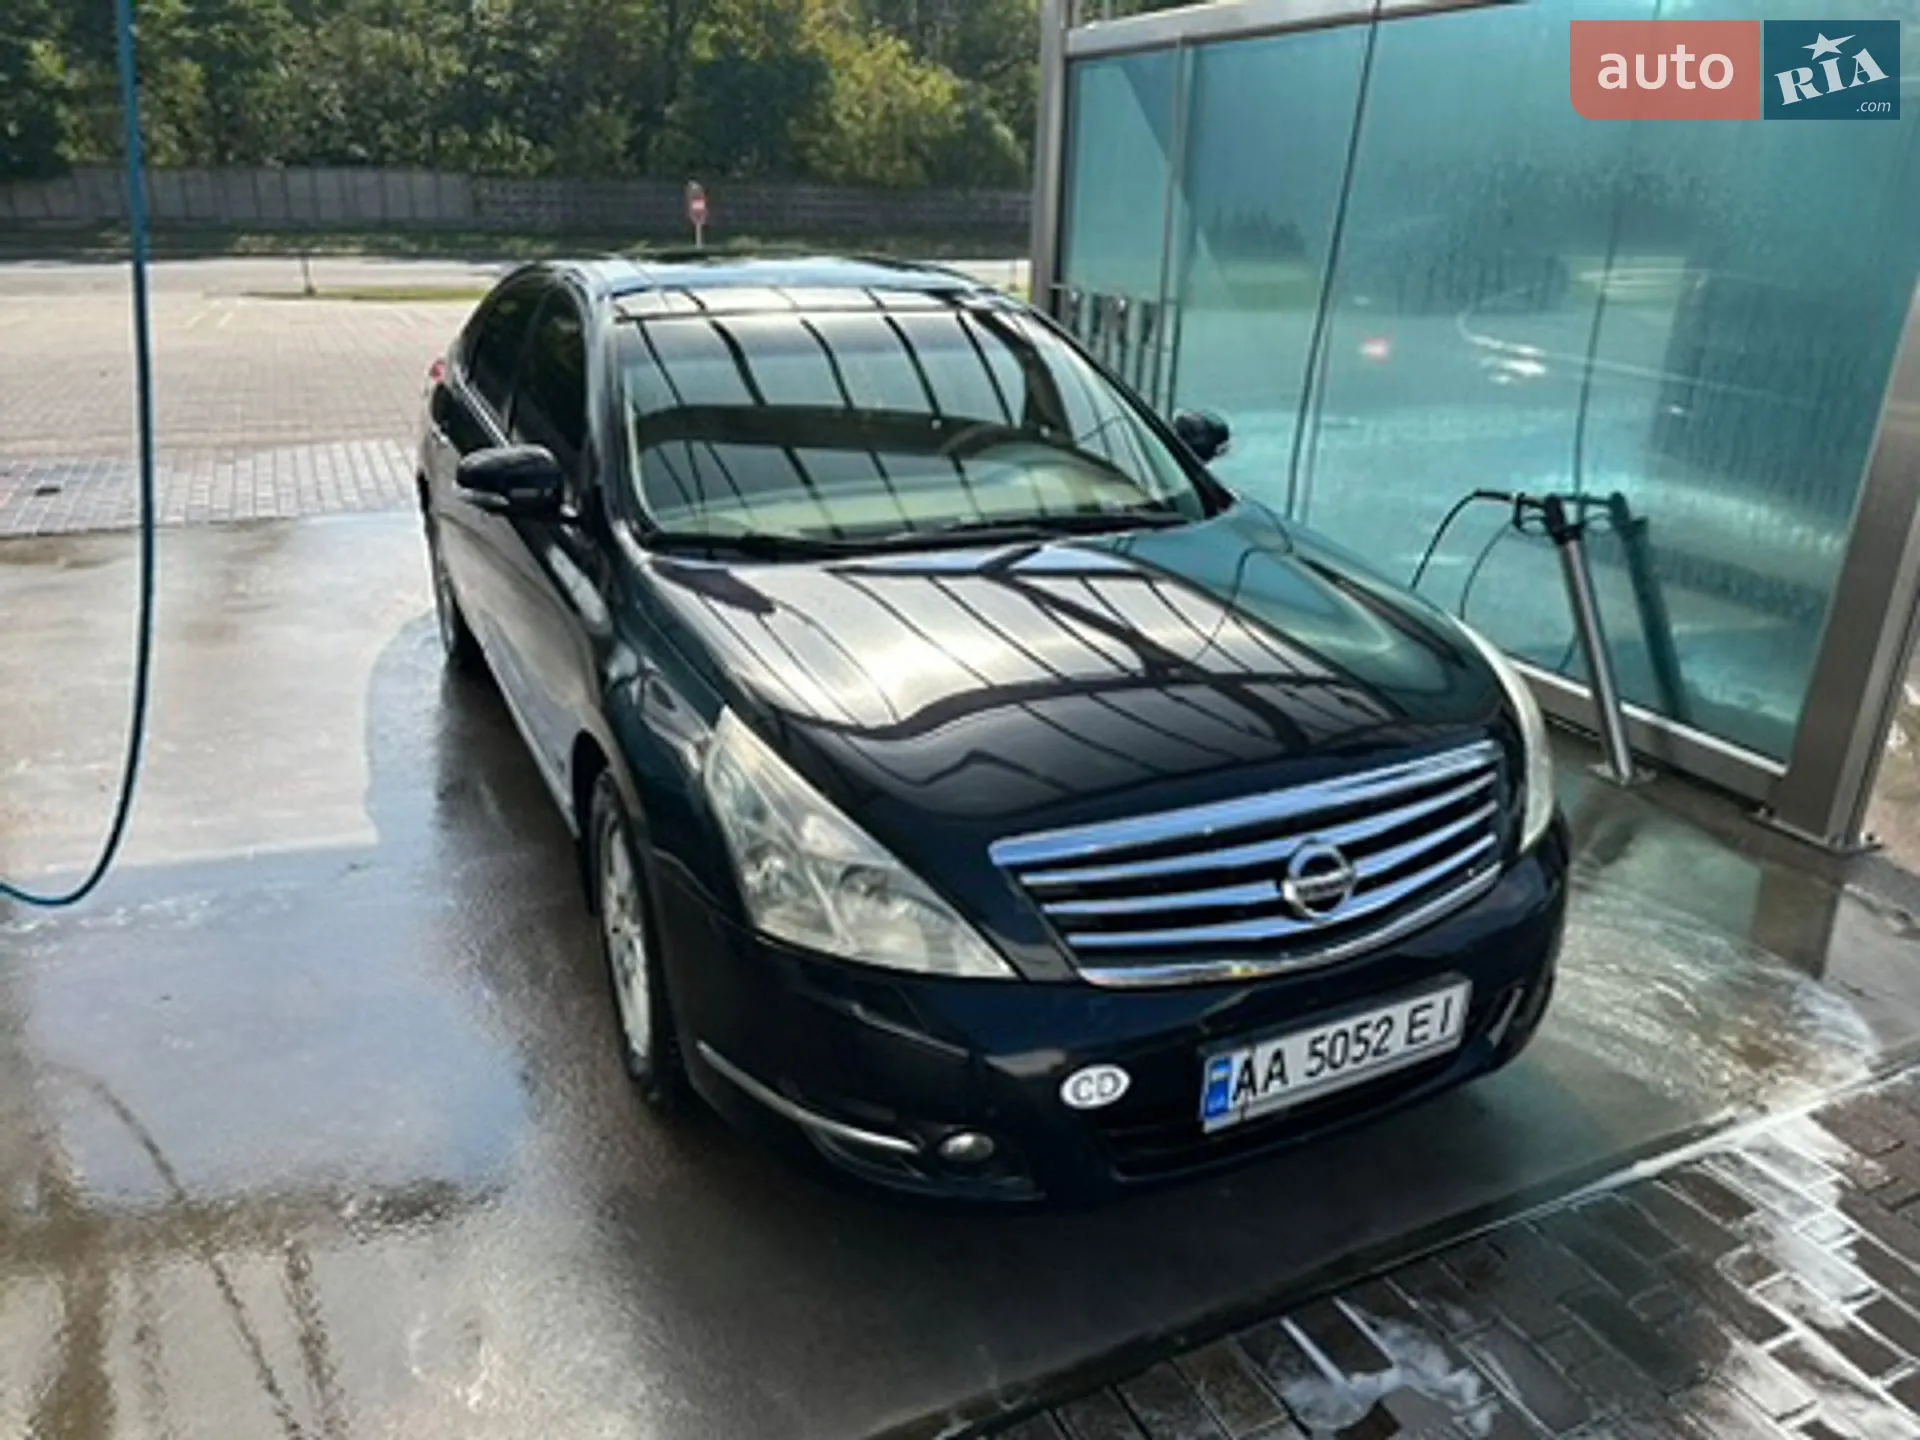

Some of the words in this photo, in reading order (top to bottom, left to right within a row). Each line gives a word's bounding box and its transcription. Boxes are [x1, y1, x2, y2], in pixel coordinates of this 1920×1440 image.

[1232, 1048, 1288, 1101] AA
[1304, 1015, 1394, 1078] 5052
[1404, 995, 1454, 1045] EI
[1072, 1071, 1121, 1101] CD
